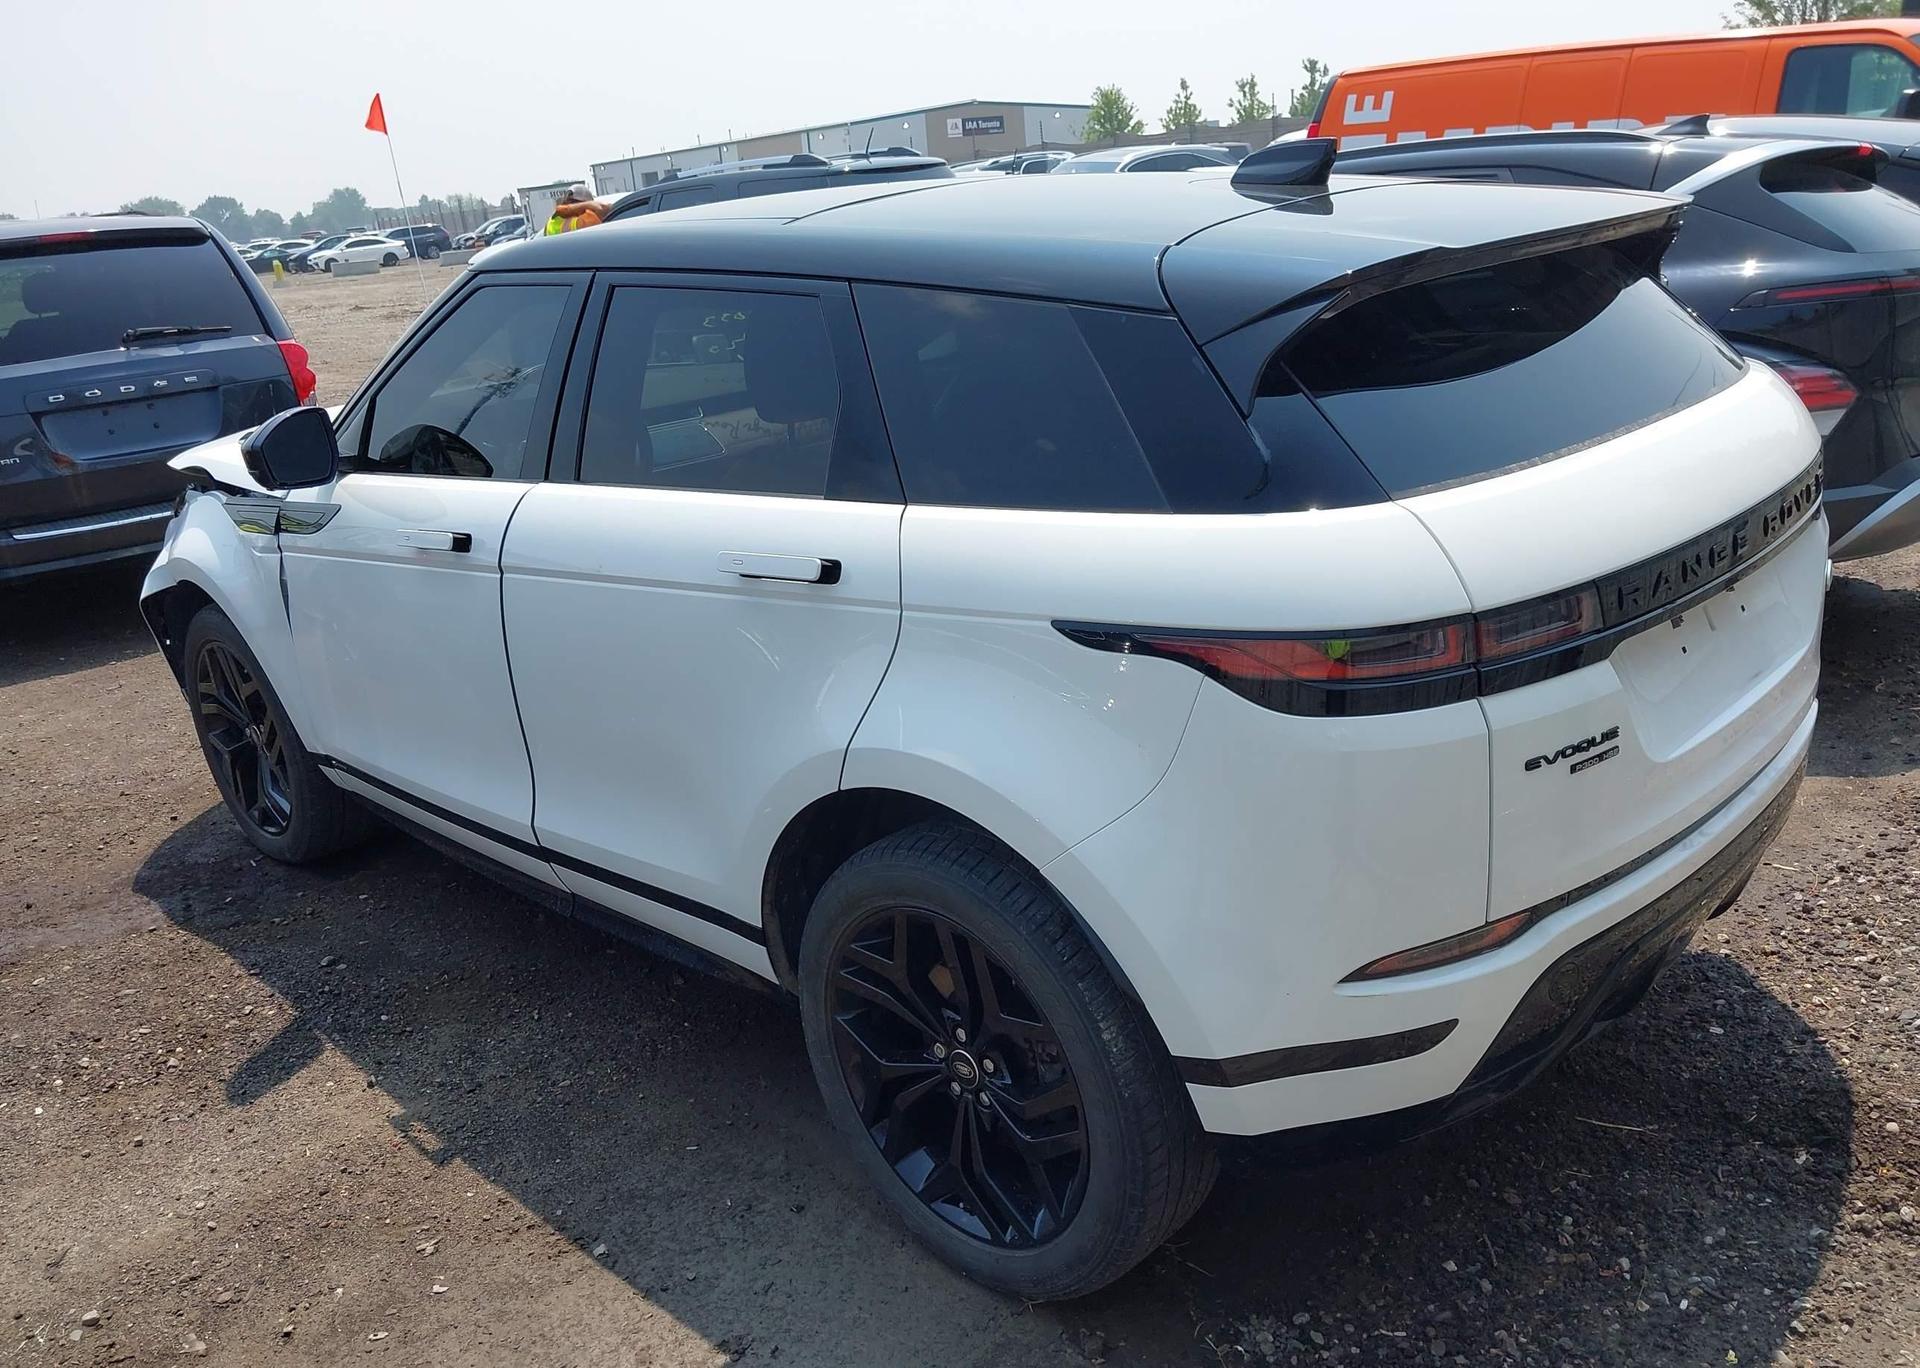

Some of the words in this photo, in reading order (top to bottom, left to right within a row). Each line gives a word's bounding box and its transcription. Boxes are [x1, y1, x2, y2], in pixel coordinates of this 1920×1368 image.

[966, 121, 977, 129] IAA
[48, 376, 199, 402] DODGE
[1617, 531, 1749, 611] RANGE
[1525, 726, 1620, 771] EVOQUE
[1576, 757, 1600, 771] P300
